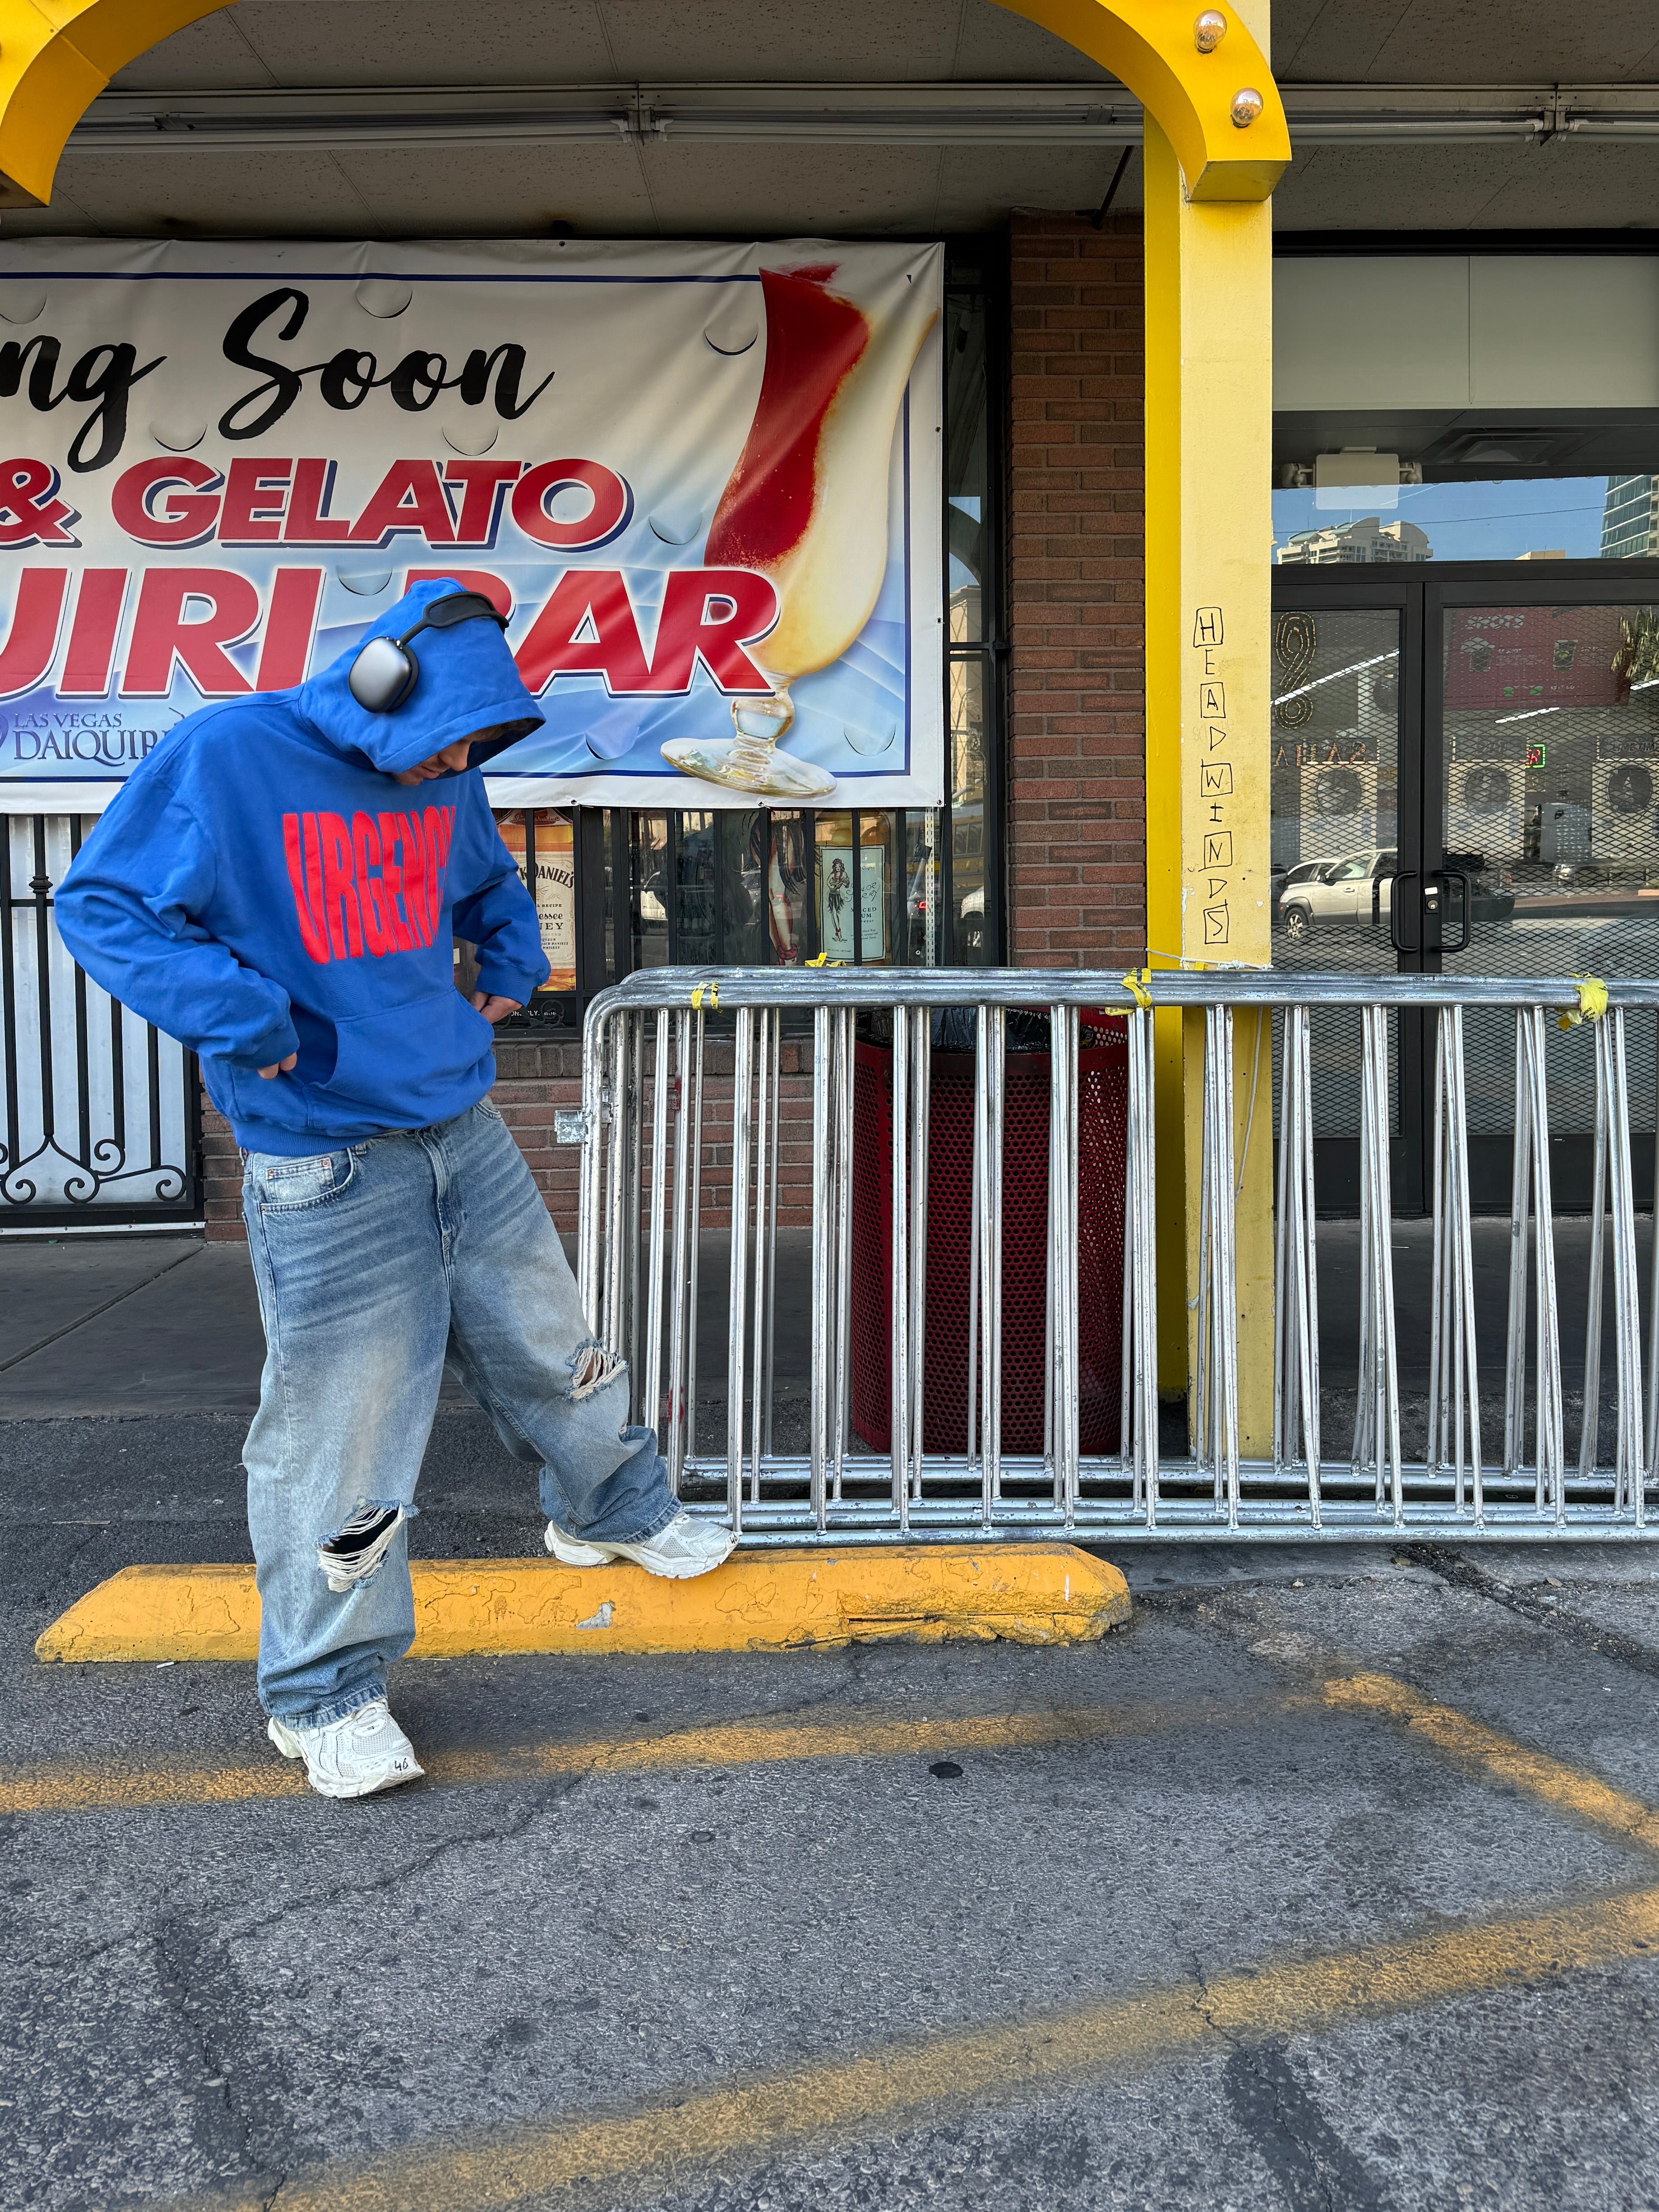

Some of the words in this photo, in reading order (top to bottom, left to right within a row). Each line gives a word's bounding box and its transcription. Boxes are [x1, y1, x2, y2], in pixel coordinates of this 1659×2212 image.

[218, 287, 555, 440] Soon
[111, 456, 634, 553] GELATO
[12, 729, 170, 767] DAIQUIR
[14, 712, 48, 728] LAS
[53, 712, 122, 729] VEGAS
